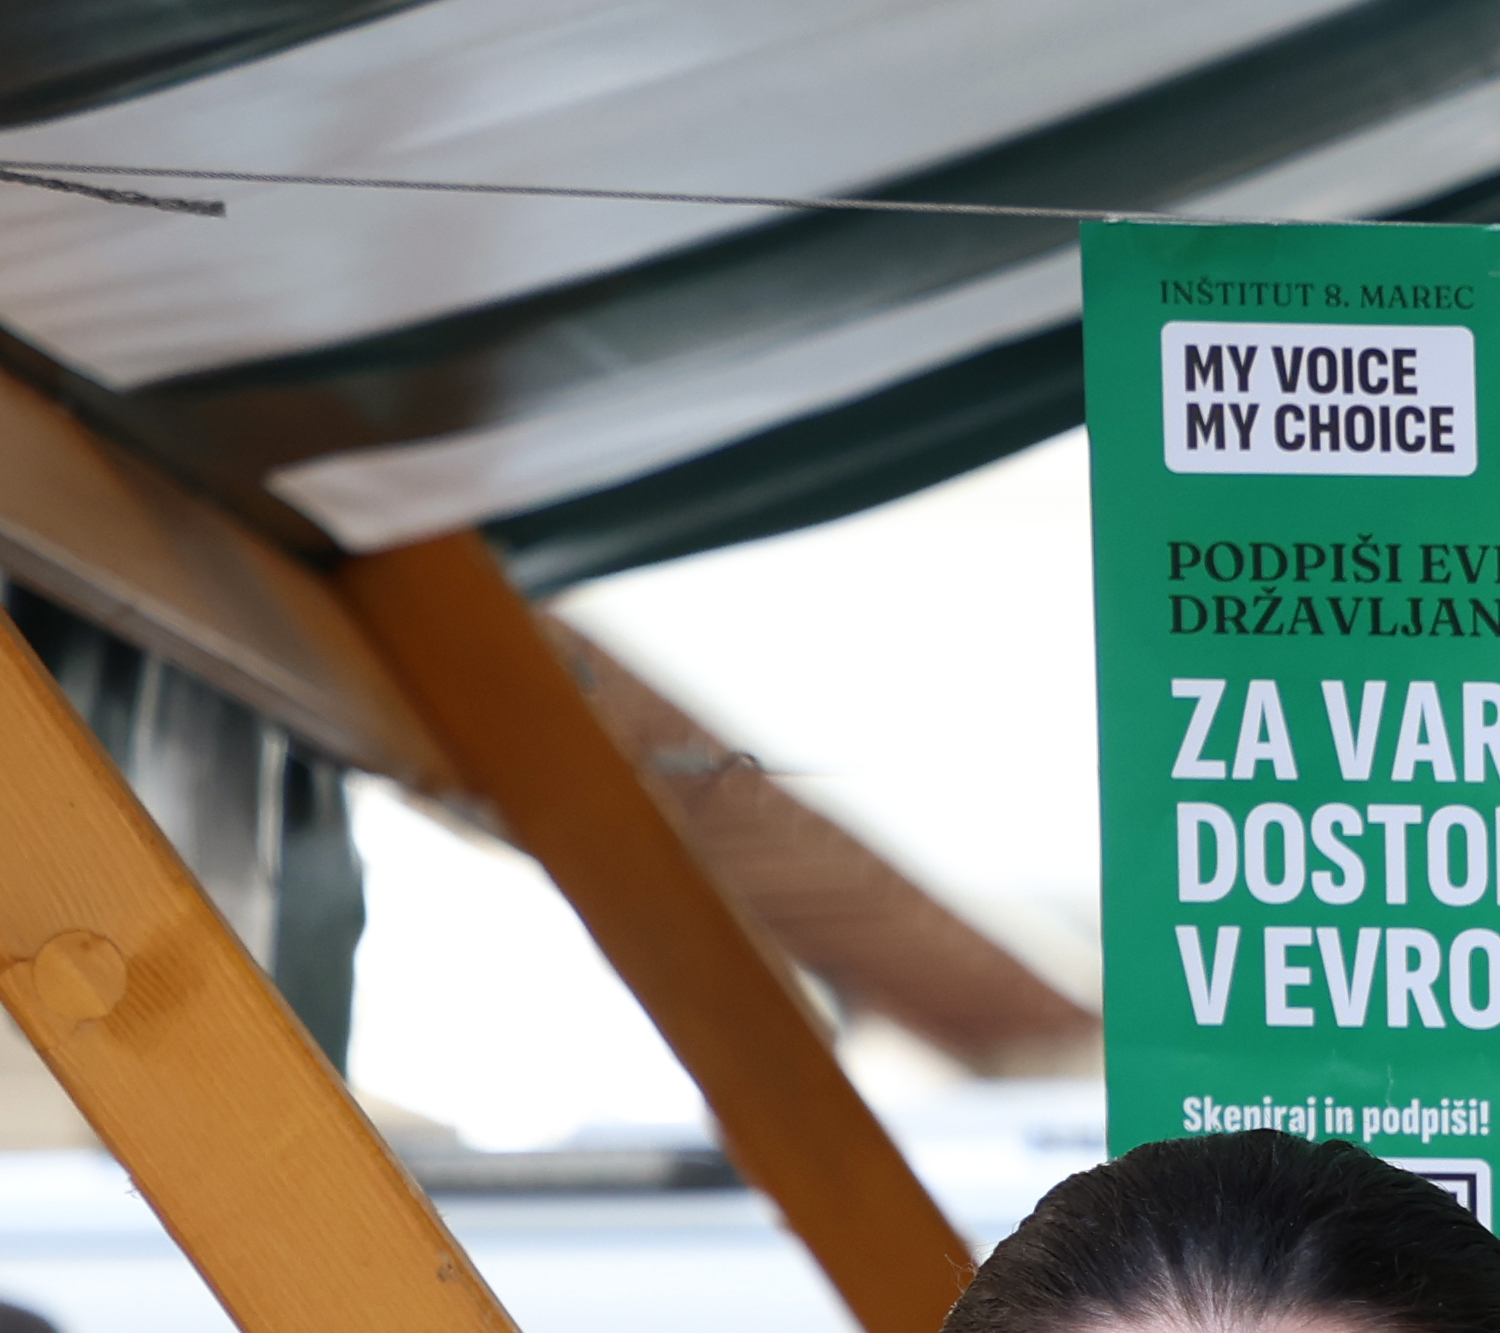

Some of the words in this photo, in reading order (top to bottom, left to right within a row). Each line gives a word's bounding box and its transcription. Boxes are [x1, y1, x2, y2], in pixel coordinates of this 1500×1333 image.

[1160, 280, 1315, 306] INŠTITUT
[1324, 284, 1351, 308] 8.
[1365, 285, 1475, 311] MAREC
[1184, 345, 1257, 393] MY
[1271, 346, 1418, 396] VOICE
[1186, 402, 1259, 451] MY
[1274, 404, 1455, 454] CHOICE
[1166, 535, 1404, 585] PODPIŠI
[1170, 677, 1298, 781] ZA
[1175, 925, 1240, 1027] V
[1182, 1095, 1317, 1142] Skeniraj
[1324, 1097, 1355, 1135] in
[1362, 1098, 1491, 1144] podpiši!
